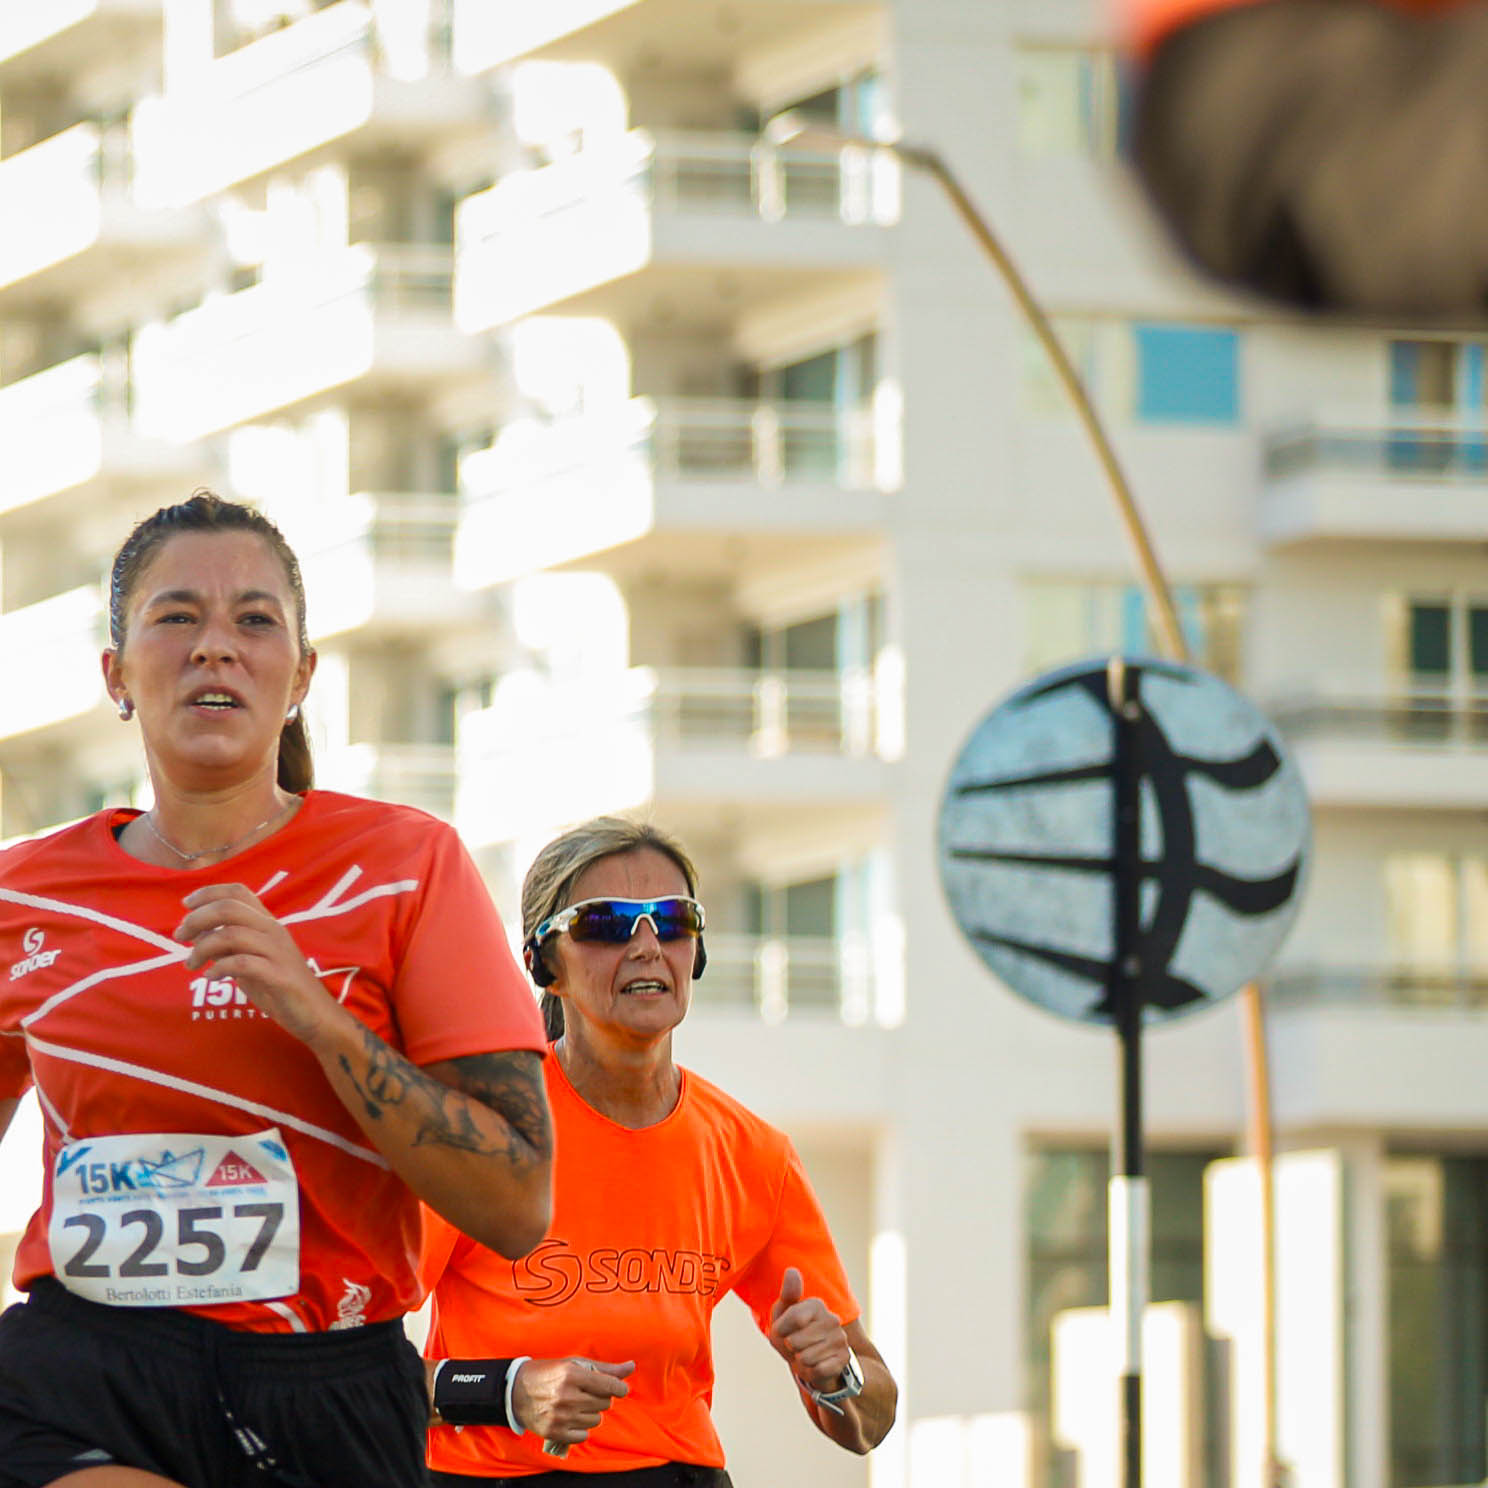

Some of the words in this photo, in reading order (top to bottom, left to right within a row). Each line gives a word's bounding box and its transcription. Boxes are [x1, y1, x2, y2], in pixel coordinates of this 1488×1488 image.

[76, 1163, 137, 1194] 15K
[219, 1164, 253, 1180] 15K
[63, 1202, 284, 1278] 2257
